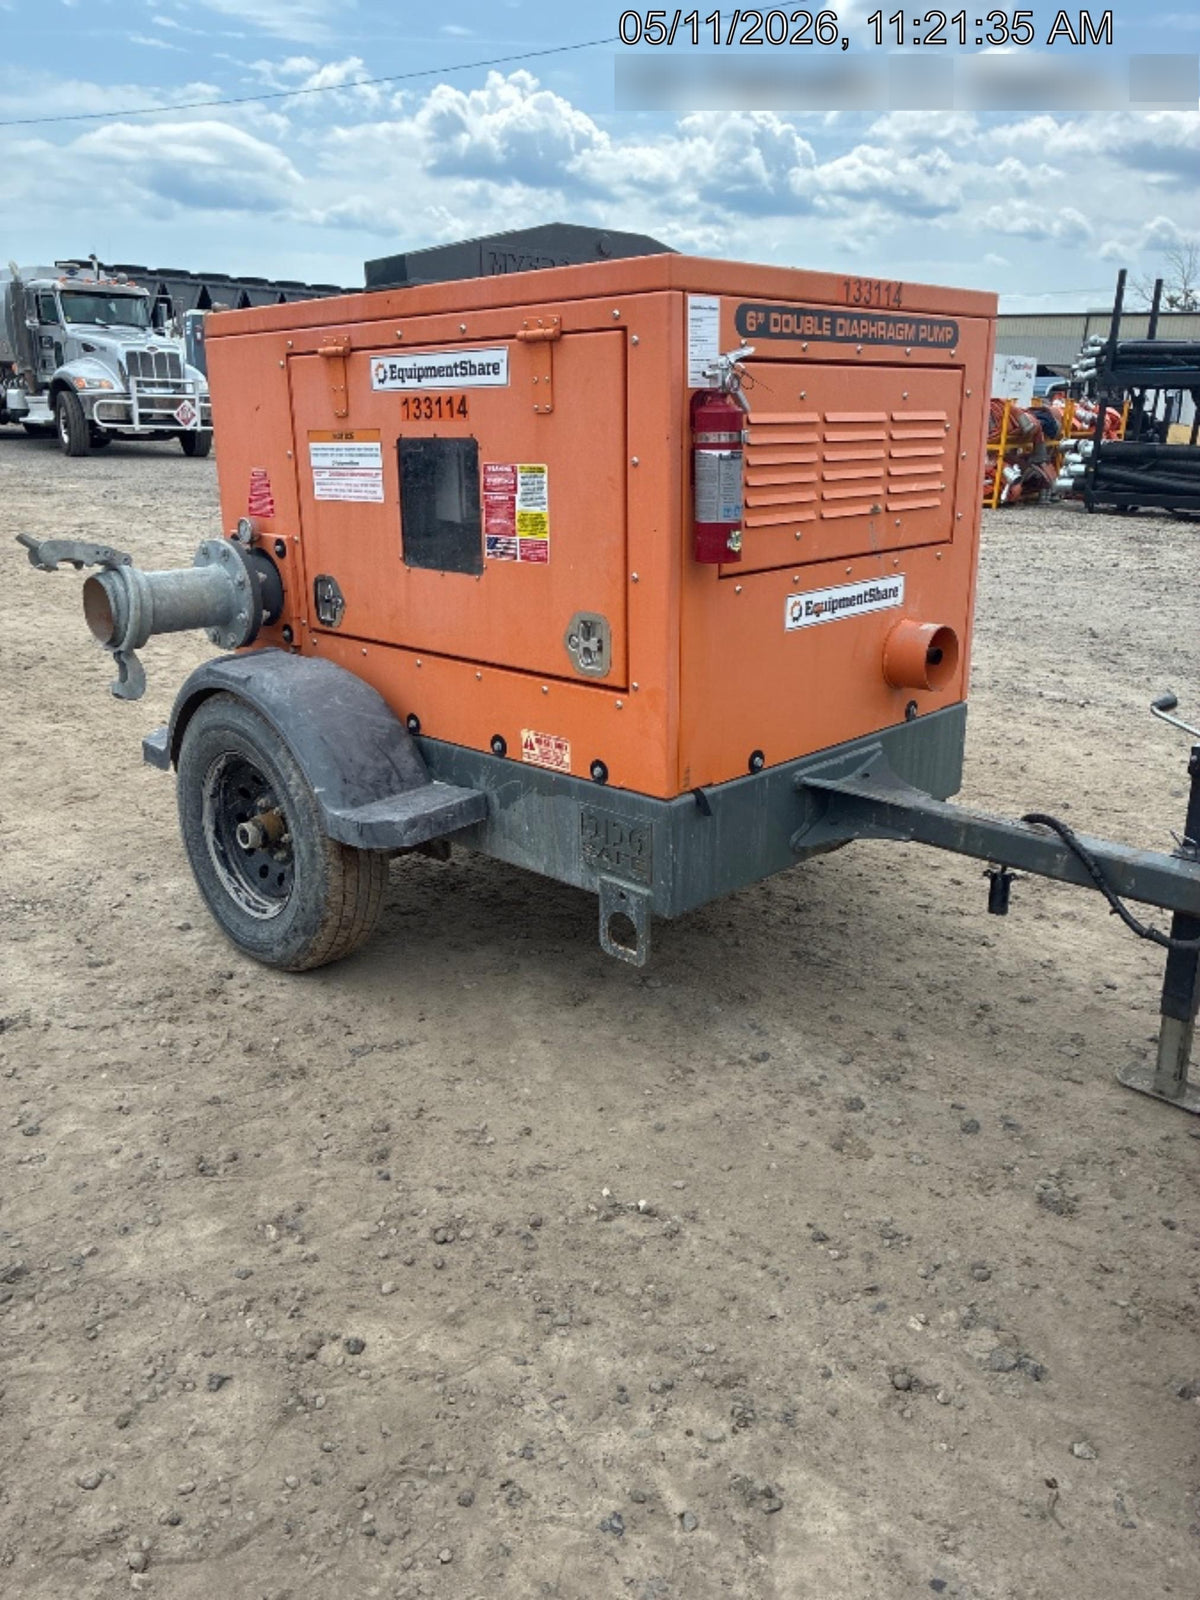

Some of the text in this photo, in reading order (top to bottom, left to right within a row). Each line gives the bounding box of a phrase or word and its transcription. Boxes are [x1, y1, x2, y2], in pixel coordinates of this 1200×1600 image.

[843, 280, 903, 308] 133114
[769, 312, 832, 337] DOUBLE
[835, 317, 916, 342] DIAPHRAGM
[918, 324, 954, 344] PUMP
[389, 360, 500, 383] EquipmentShare
[402, 395, 468, 420] 133114
[804, 585, 899, 617] EquipmentShare
